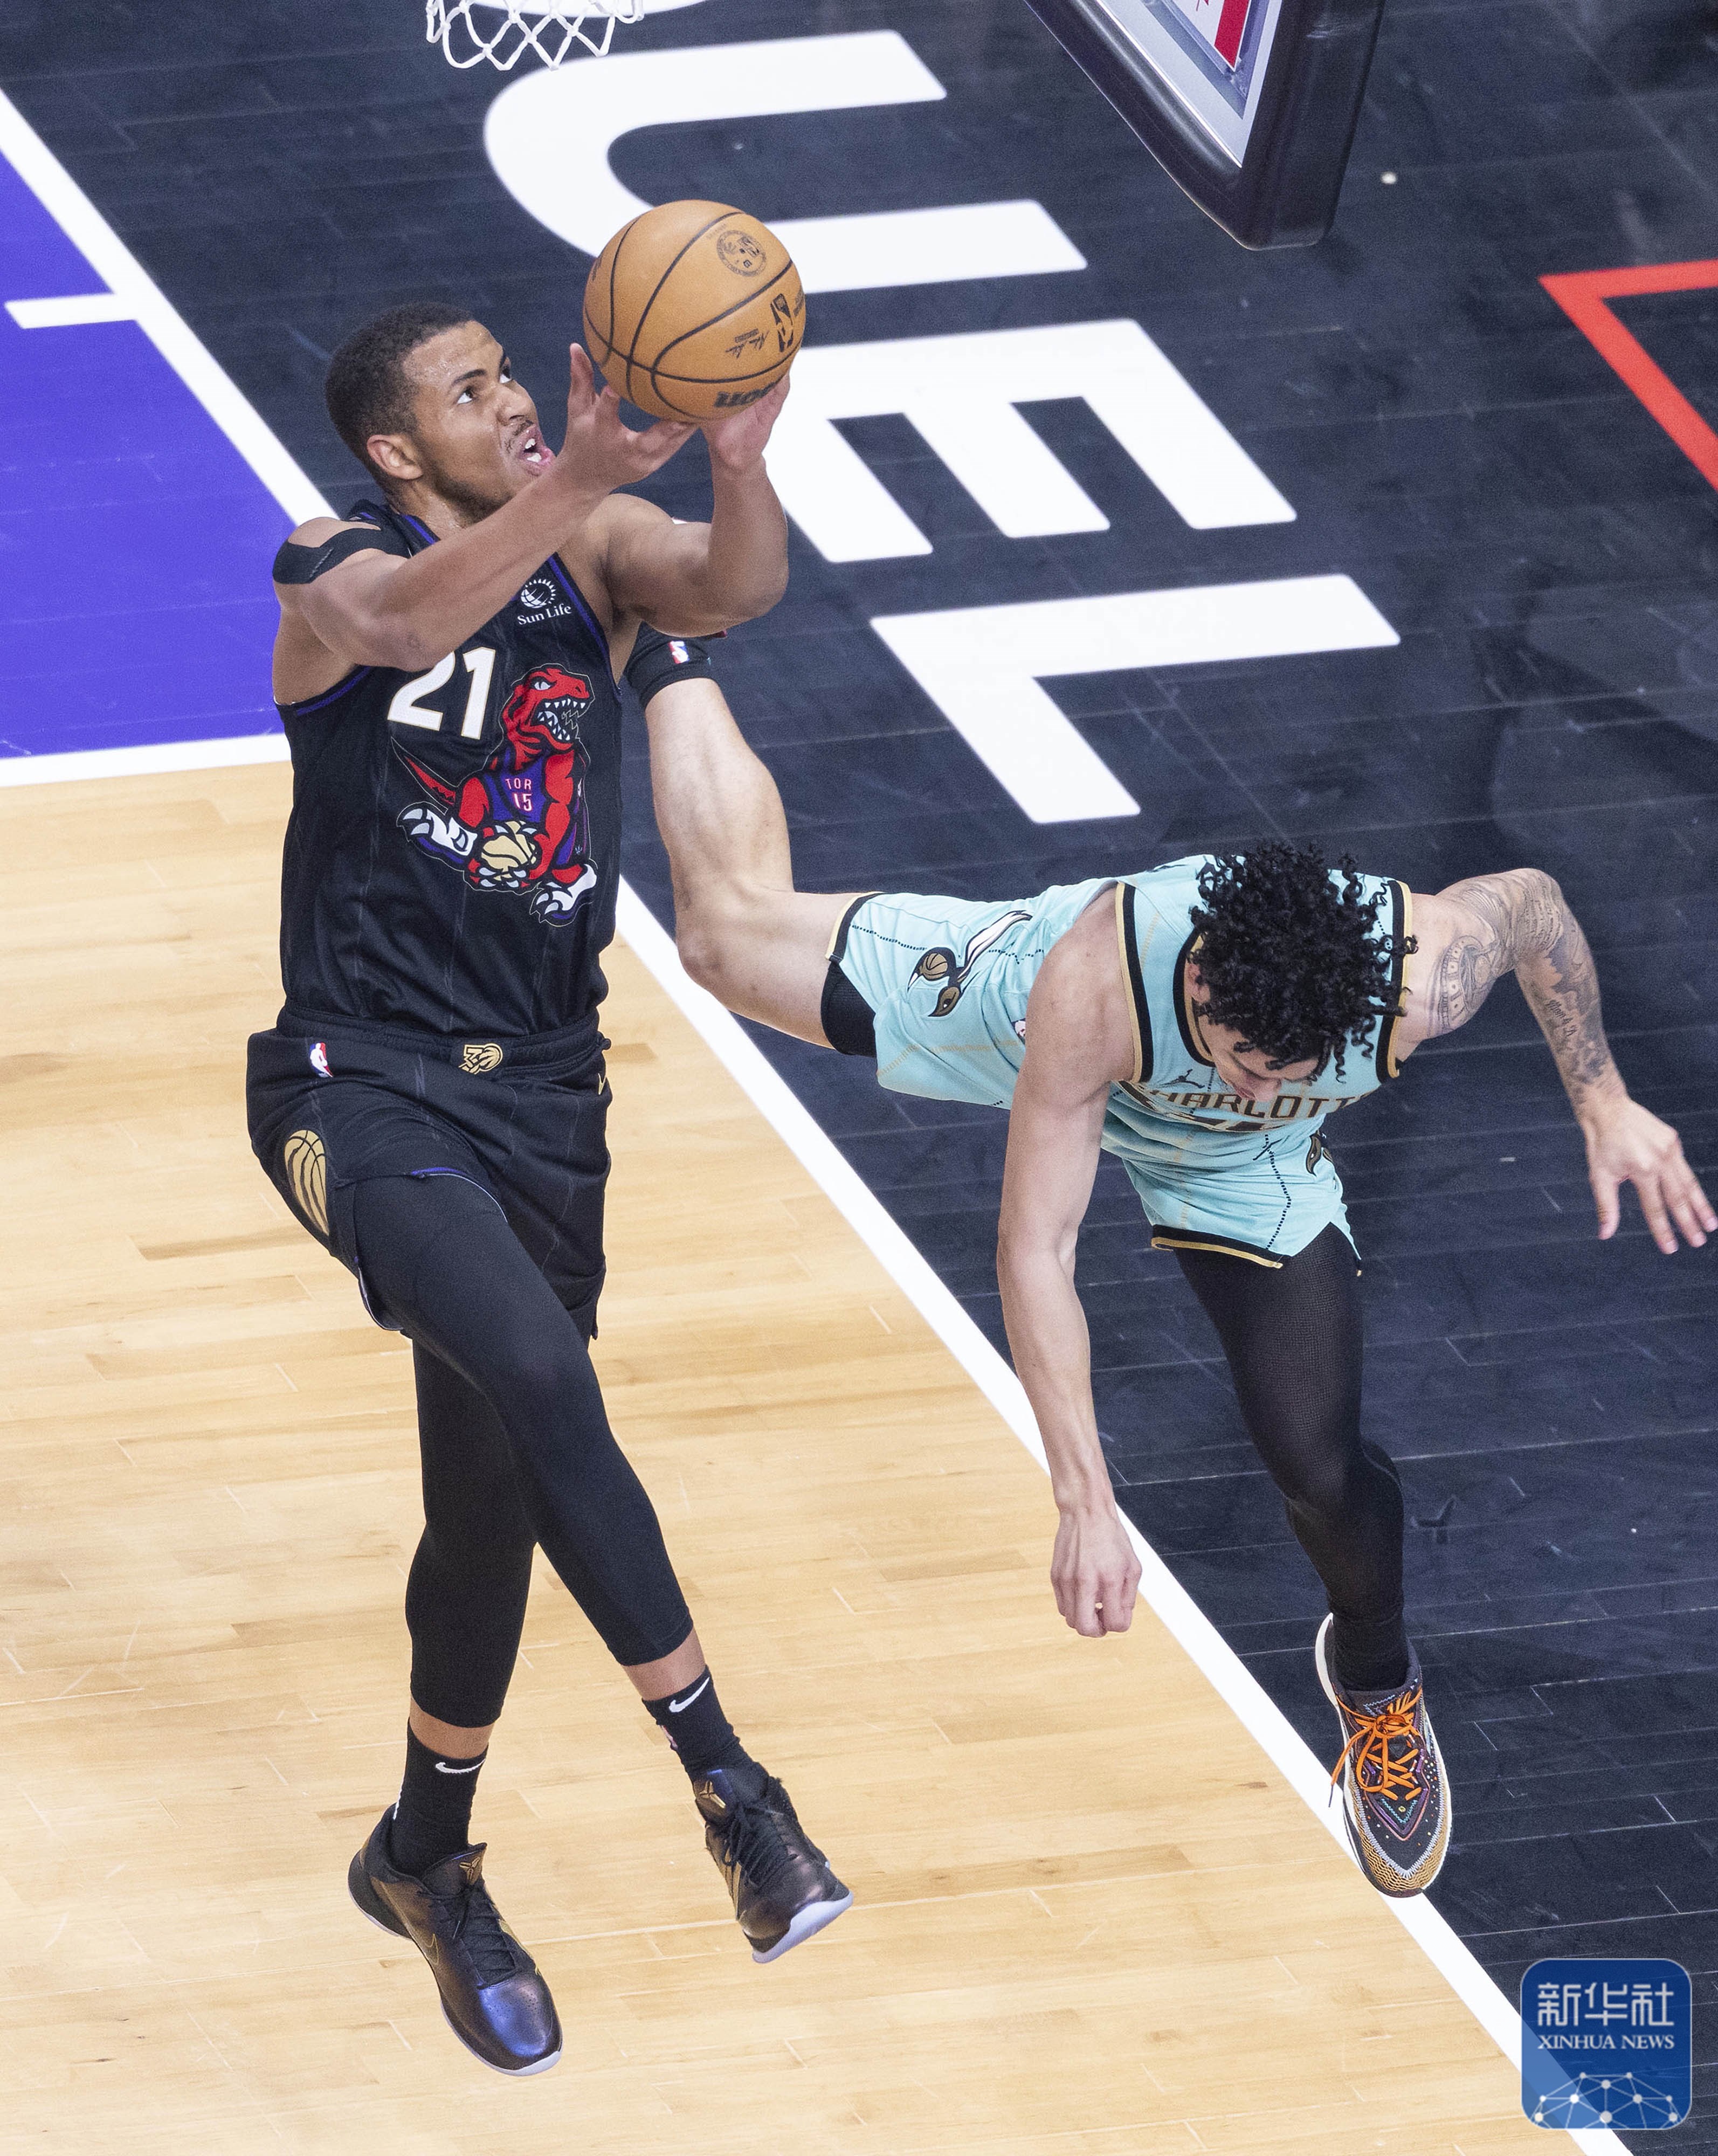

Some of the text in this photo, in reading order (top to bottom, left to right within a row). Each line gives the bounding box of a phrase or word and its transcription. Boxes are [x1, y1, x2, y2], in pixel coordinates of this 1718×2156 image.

[517, 603, 571, 625] Sun Life
[387, 646, 496, 740] 21
[505, 778, 532, 791] TOR
[514, 793, 533, 812] 15
